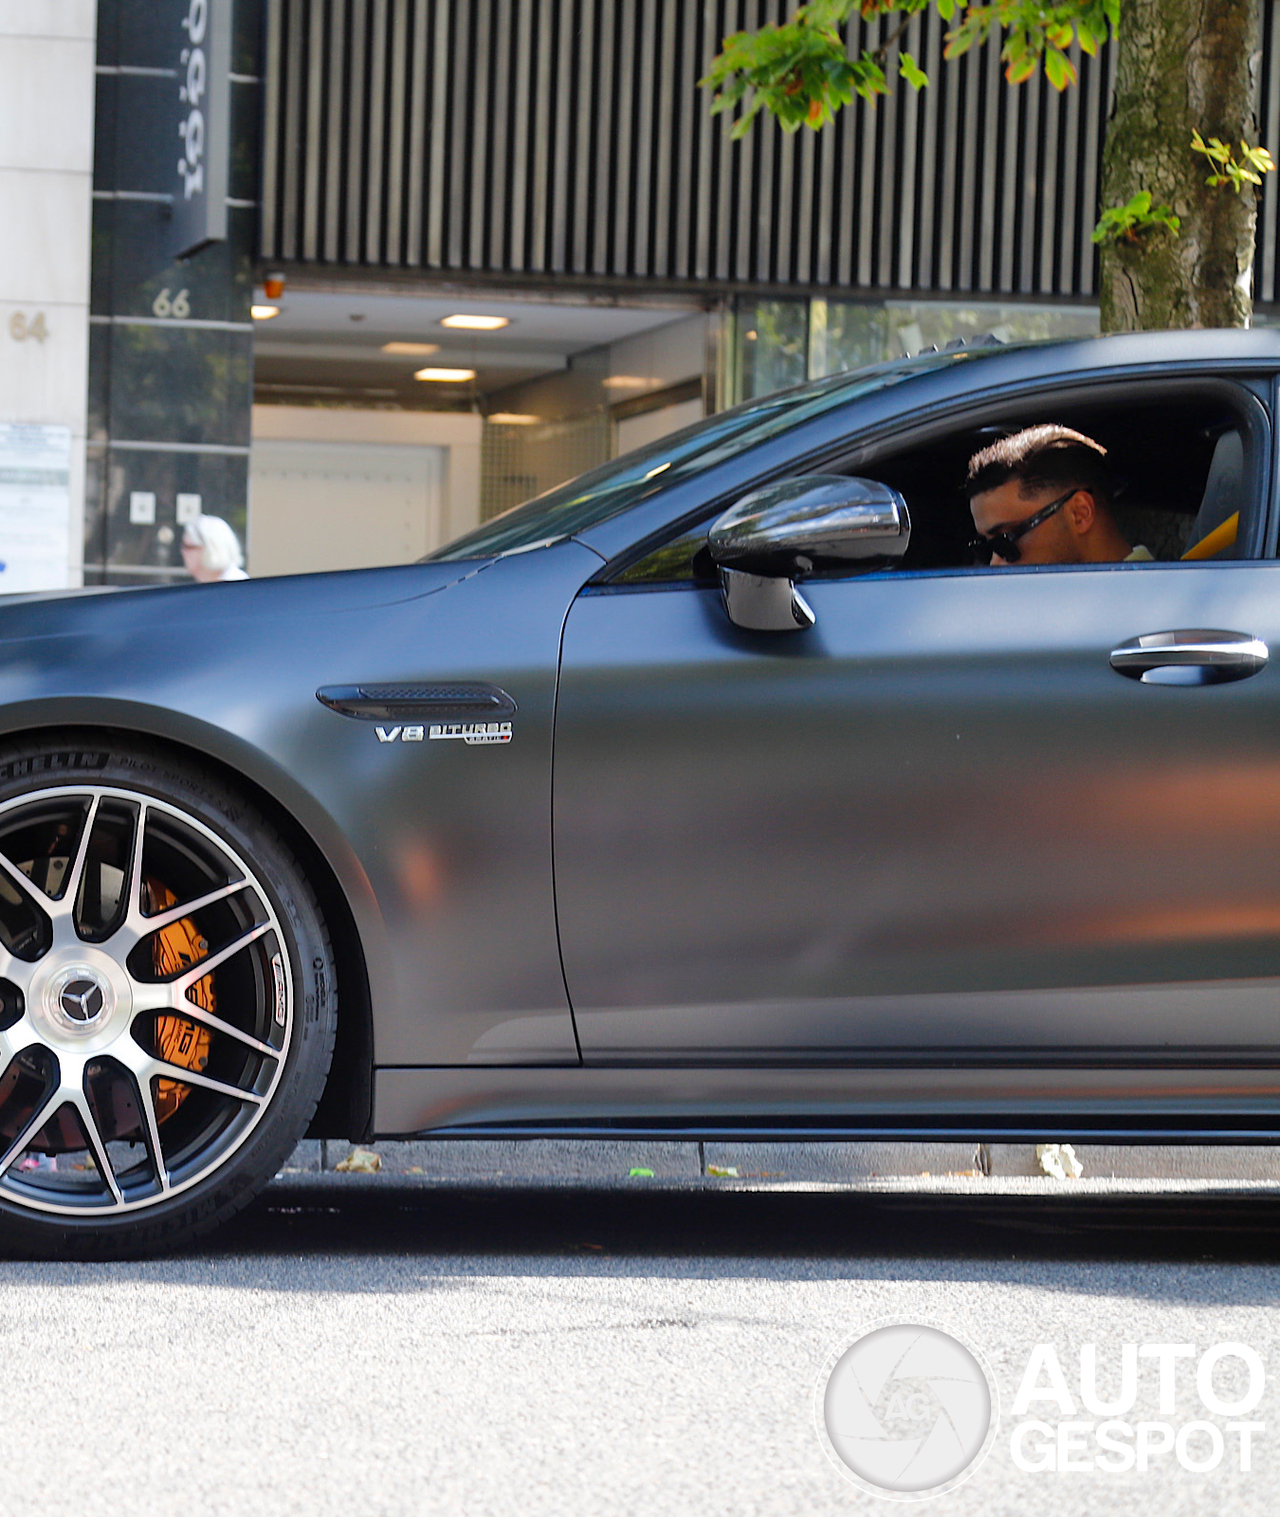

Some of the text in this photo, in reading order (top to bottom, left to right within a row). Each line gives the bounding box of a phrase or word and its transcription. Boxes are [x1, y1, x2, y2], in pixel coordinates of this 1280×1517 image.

[152, 288, 191, 318] 66
[10, 312, 49, 344] 64
[375, 722, 512, 742] V8 BITURBO
